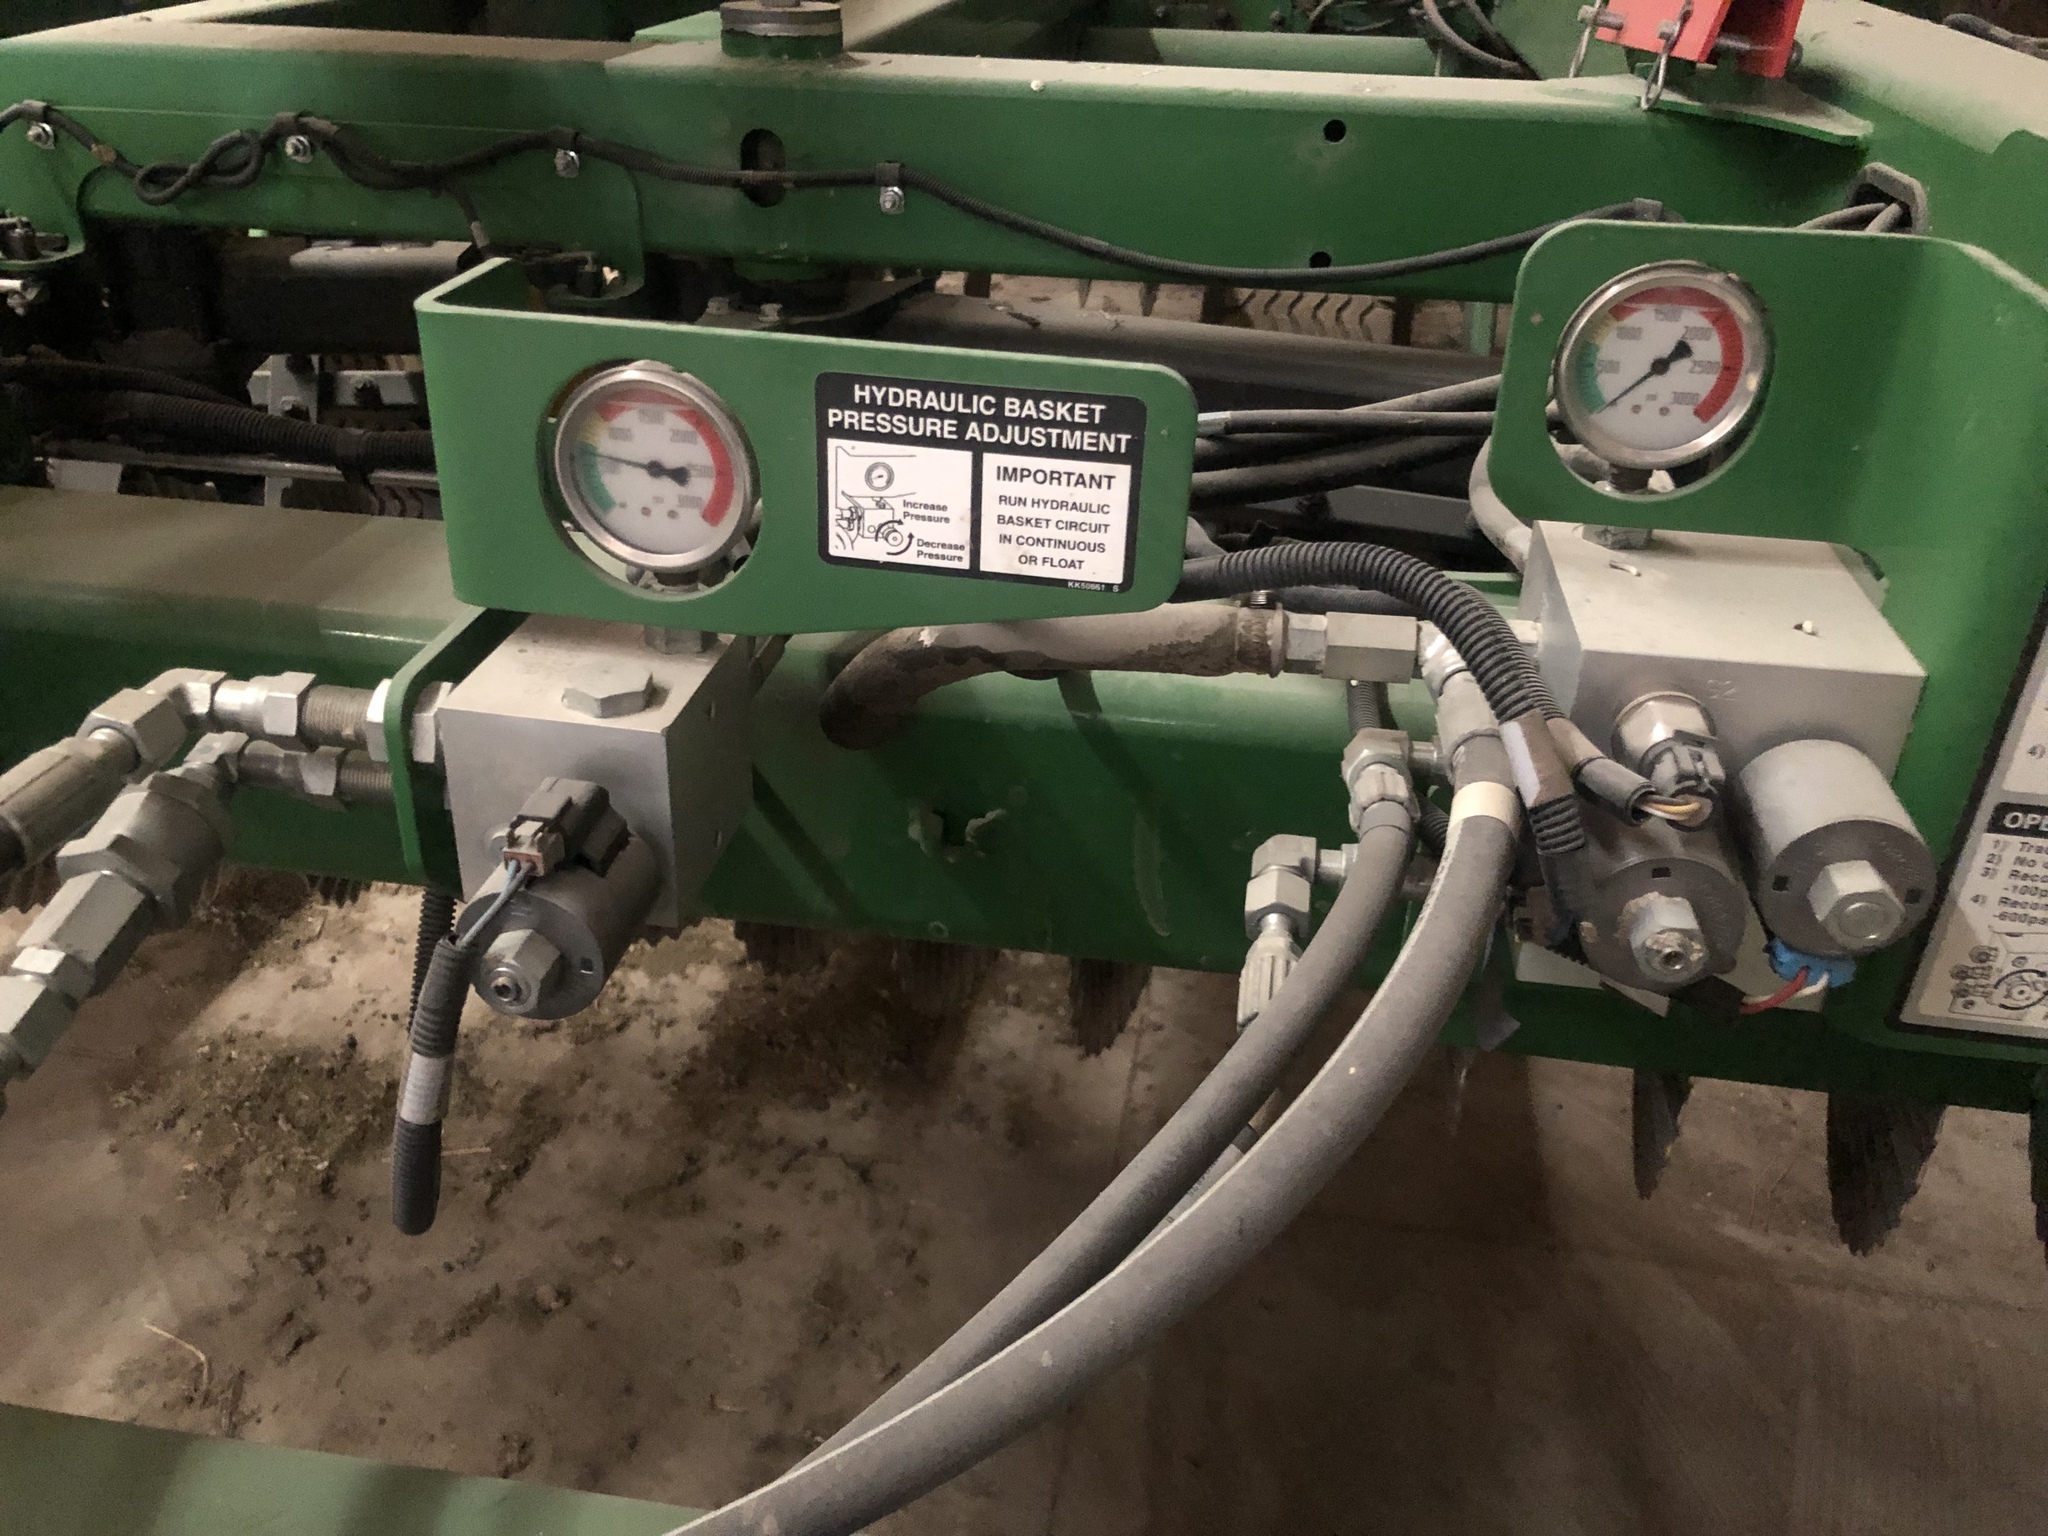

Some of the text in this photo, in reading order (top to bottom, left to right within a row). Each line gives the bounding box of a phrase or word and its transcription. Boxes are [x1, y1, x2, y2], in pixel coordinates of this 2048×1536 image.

[854, 384, 1106, 424] HYDRAULIC BASKET
[828, 409, 1132, 453] PRESSURE ADJUSTMENT
[996, 466, 1116, 490] IMPORTANT
[903, 499, 948, 512] Increase
[998, 495, 1111, 515] RUN HYDRAULIC
[903, 511, 950, 524] Pressure
[997, 514, 1110, 534] BASKET CIRCUIT
[917, 538, 965, 551] Decrease
[999, 534, 1106, 553] IN CONTINUOUS
[917, 550, 963, 562] Pressure
[1018, 554, 1085, 570] OR FLOAT
